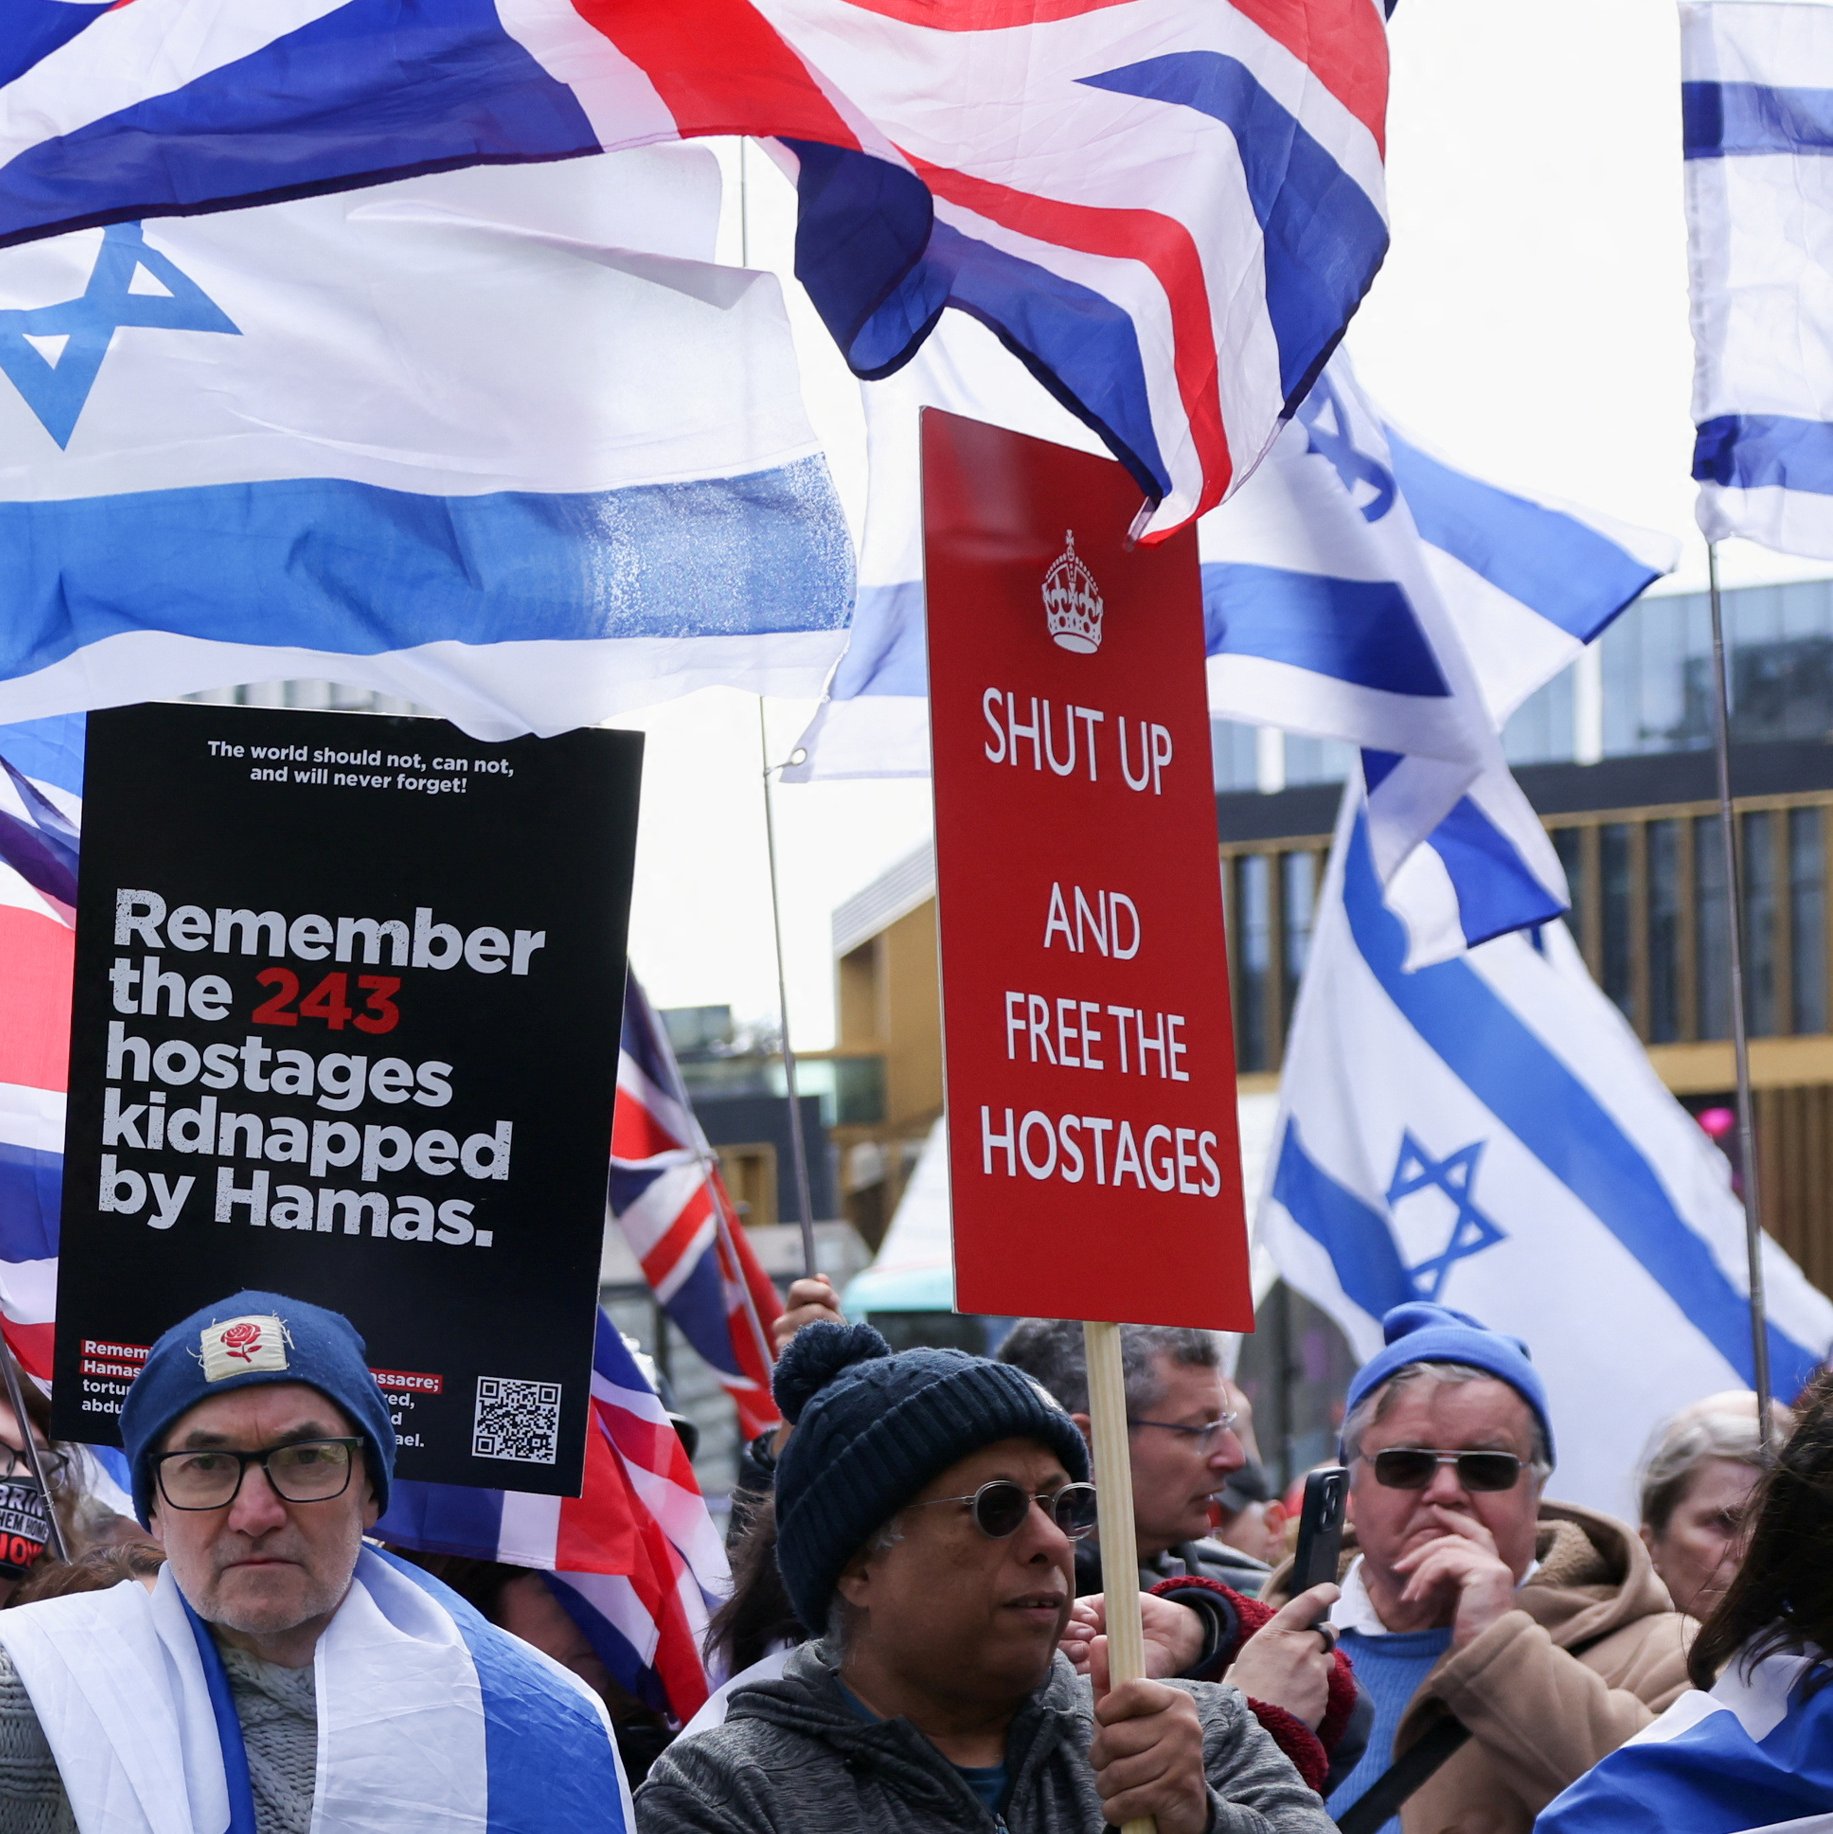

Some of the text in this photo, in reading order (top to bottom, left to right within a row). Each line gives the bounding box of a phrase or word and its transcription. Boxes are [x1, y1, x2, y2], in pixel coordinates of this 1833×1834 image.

[208, 741, 514, 777] The world should not, can not,
[250, 766, 467, 795] and will never forget!
[983, 687, 1173, 795] SHUT UP
[114, 888, 546, 975] Remember
[1044, 881, 1141, 960] AND
[109, 956, 402, 1034] the 243
[1005, 991, 1190, 1082] FREE THE
[106, 1020, 453, 1111] hostages
[102, 1087, 513, 1182] kidnapped
[980, 1105, 1221, 1198] HOSTAGES
[98, 1154, 493, 1247] by Hamas.
[85, 1341, 152, 1359] Remem
[25, 1516, 49, 1540] HOME
